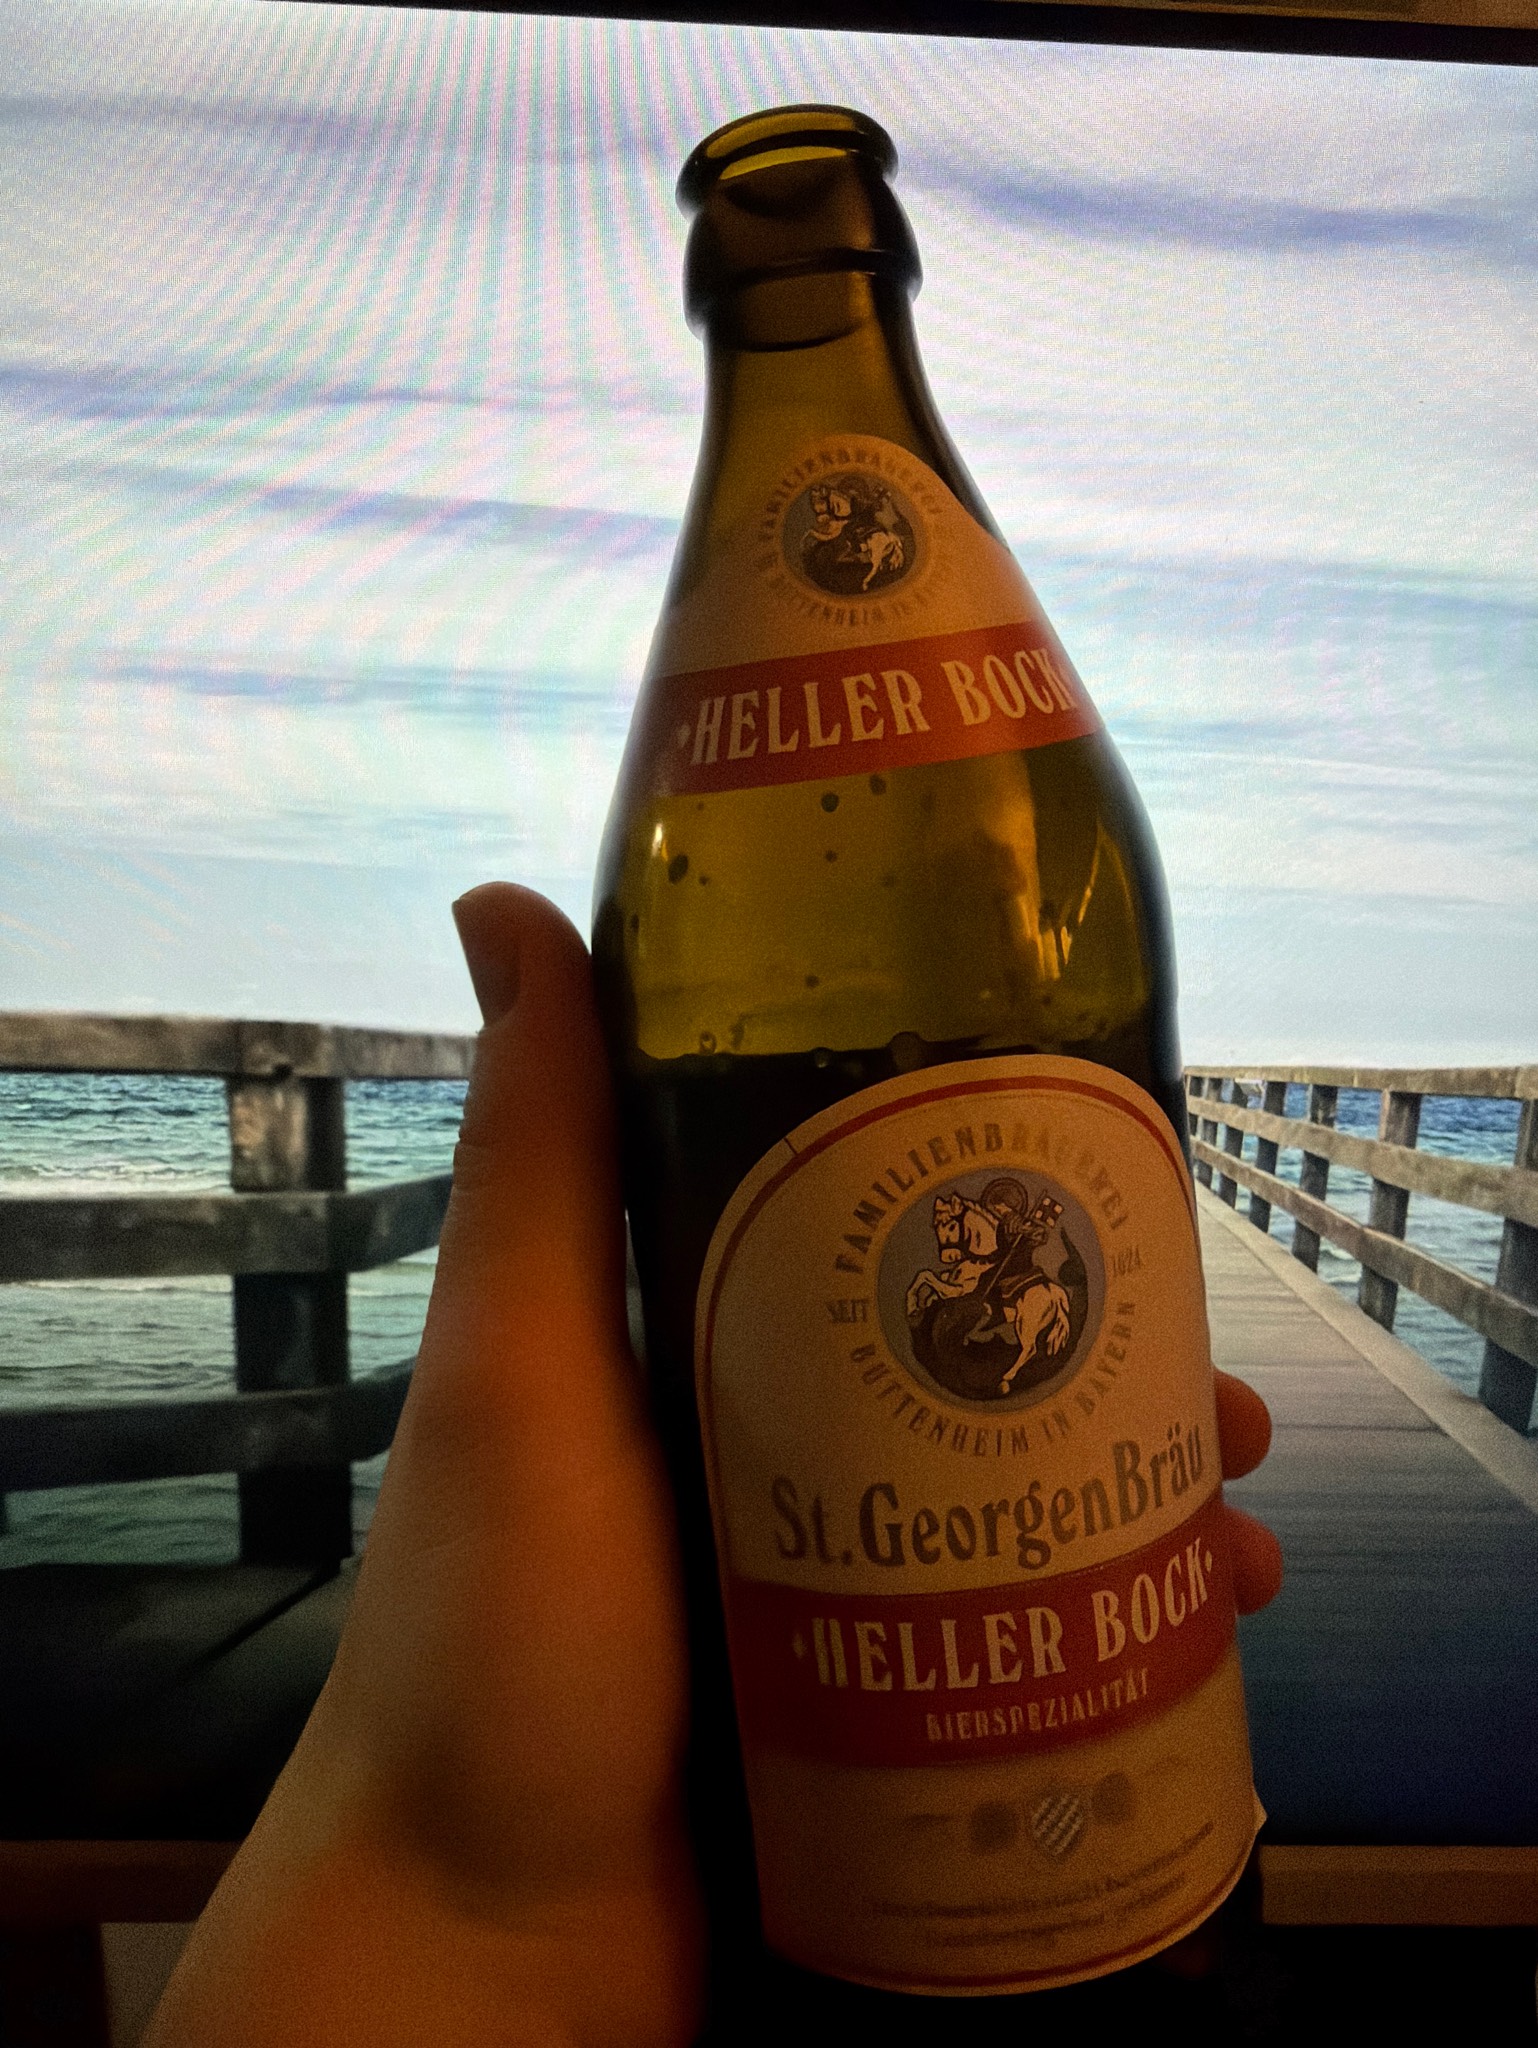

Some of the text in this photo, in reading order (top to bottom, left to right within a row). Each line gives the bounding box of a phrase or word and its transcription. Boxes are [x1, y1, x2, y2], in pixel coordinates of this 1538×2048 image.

[690, 648, 1076, 766] HELLER BOCK
[850, 1301, 1136, 1456] BUTTENHEIM IN BAYERN
[812, 1537, 1208, 1691] HELLER BOCK
